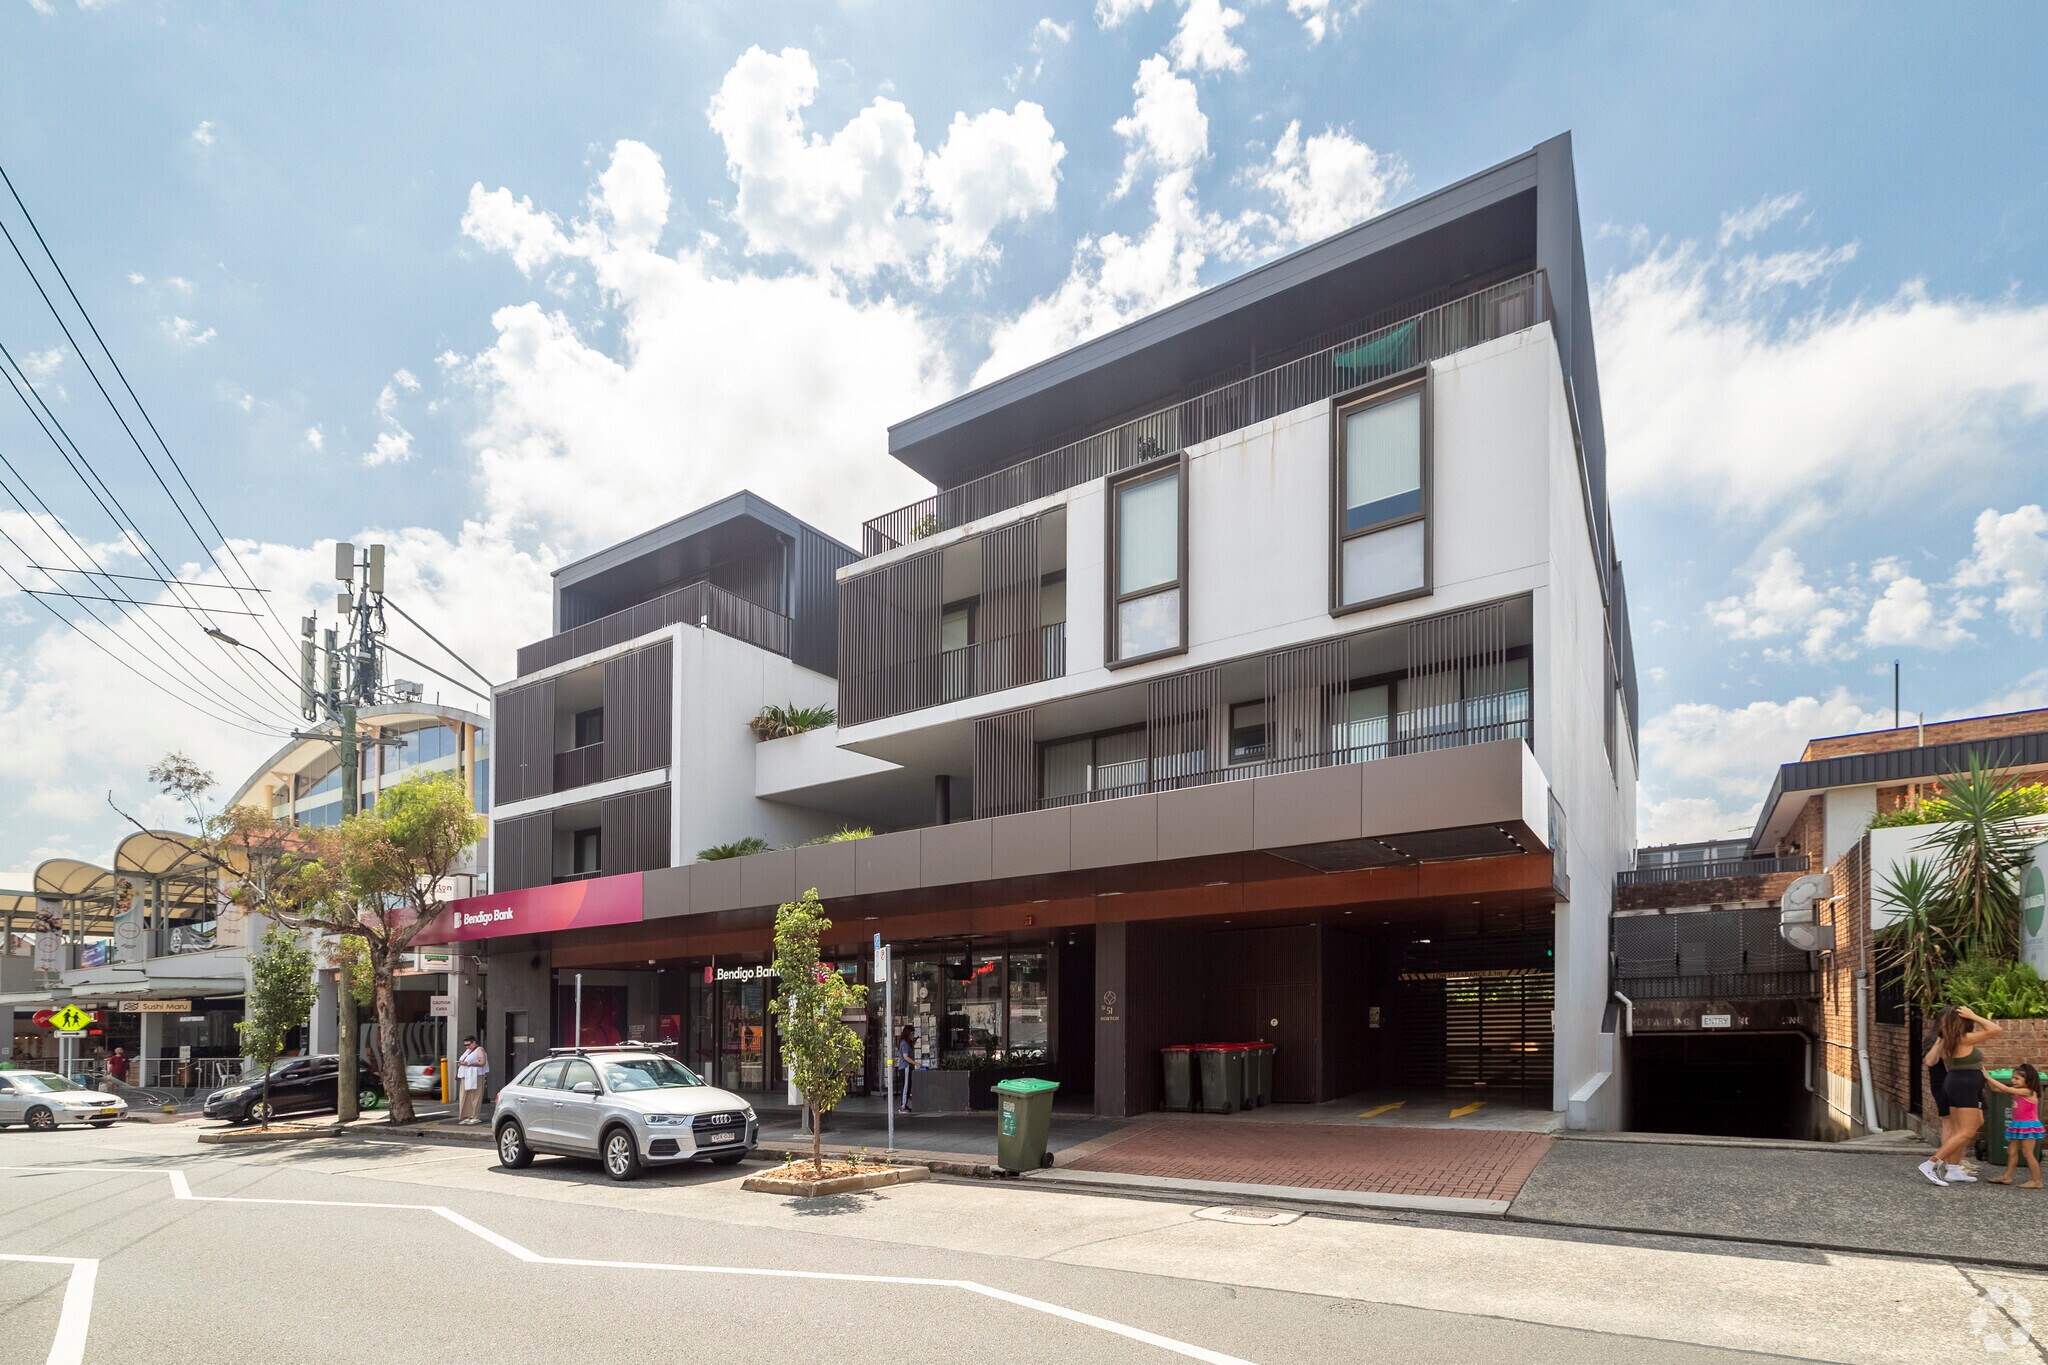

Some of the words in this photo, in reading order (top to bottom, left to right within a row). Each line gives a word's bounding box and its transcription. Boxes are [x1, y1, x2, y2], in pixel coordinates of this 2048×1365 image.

[463, 911, 493, 926] Bendigo
[493, 907, 514, 921] Bank
[717, 966, 754, 983] Bendigo
[1703, 1017, 1729, 1026] ENTRY
